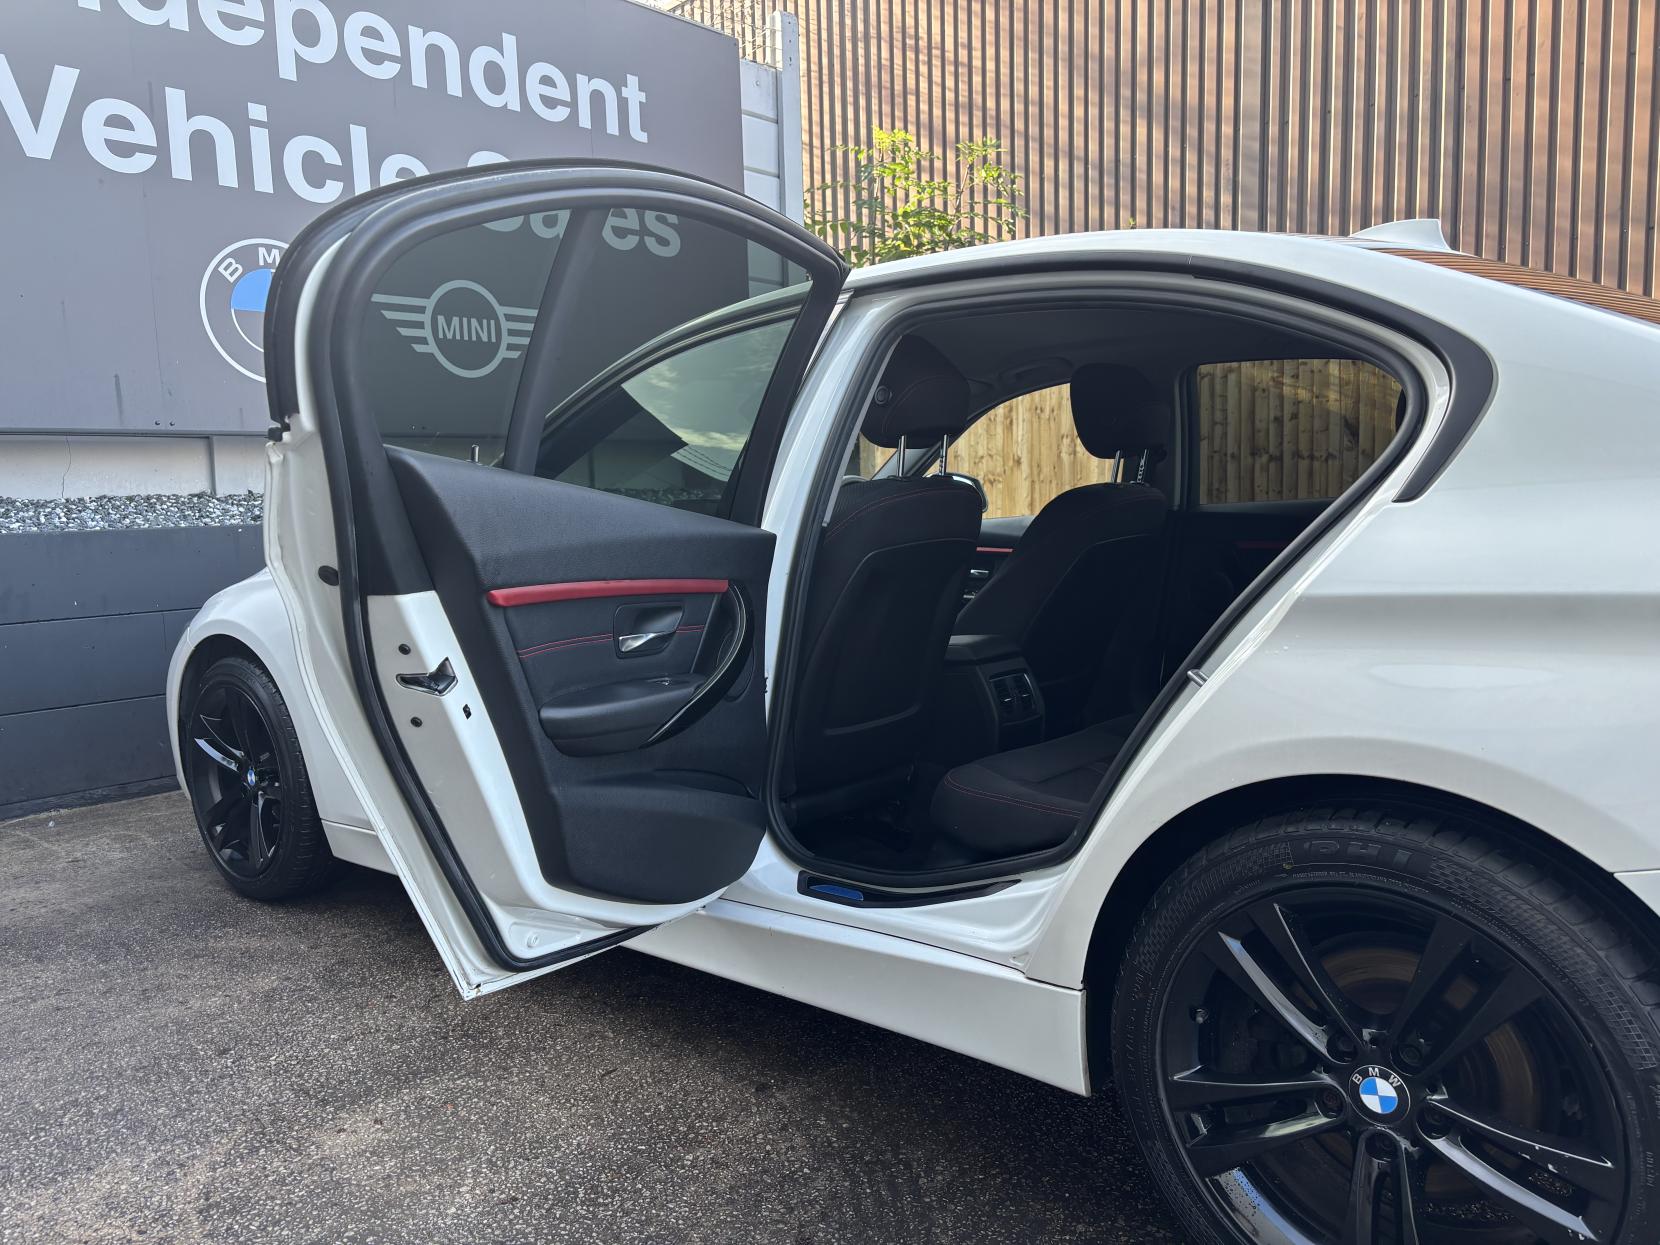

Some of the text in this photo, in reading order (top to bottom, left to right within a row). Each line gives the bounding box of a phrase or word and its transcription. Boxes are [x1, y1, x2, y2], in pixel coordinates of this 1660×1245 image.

[78, 0, 648, 143] ependent
[218, 247, 281, 283] BM
[437, 315, 496, 343] MINI
[1352, 1067, 1401, 1087] BMW
